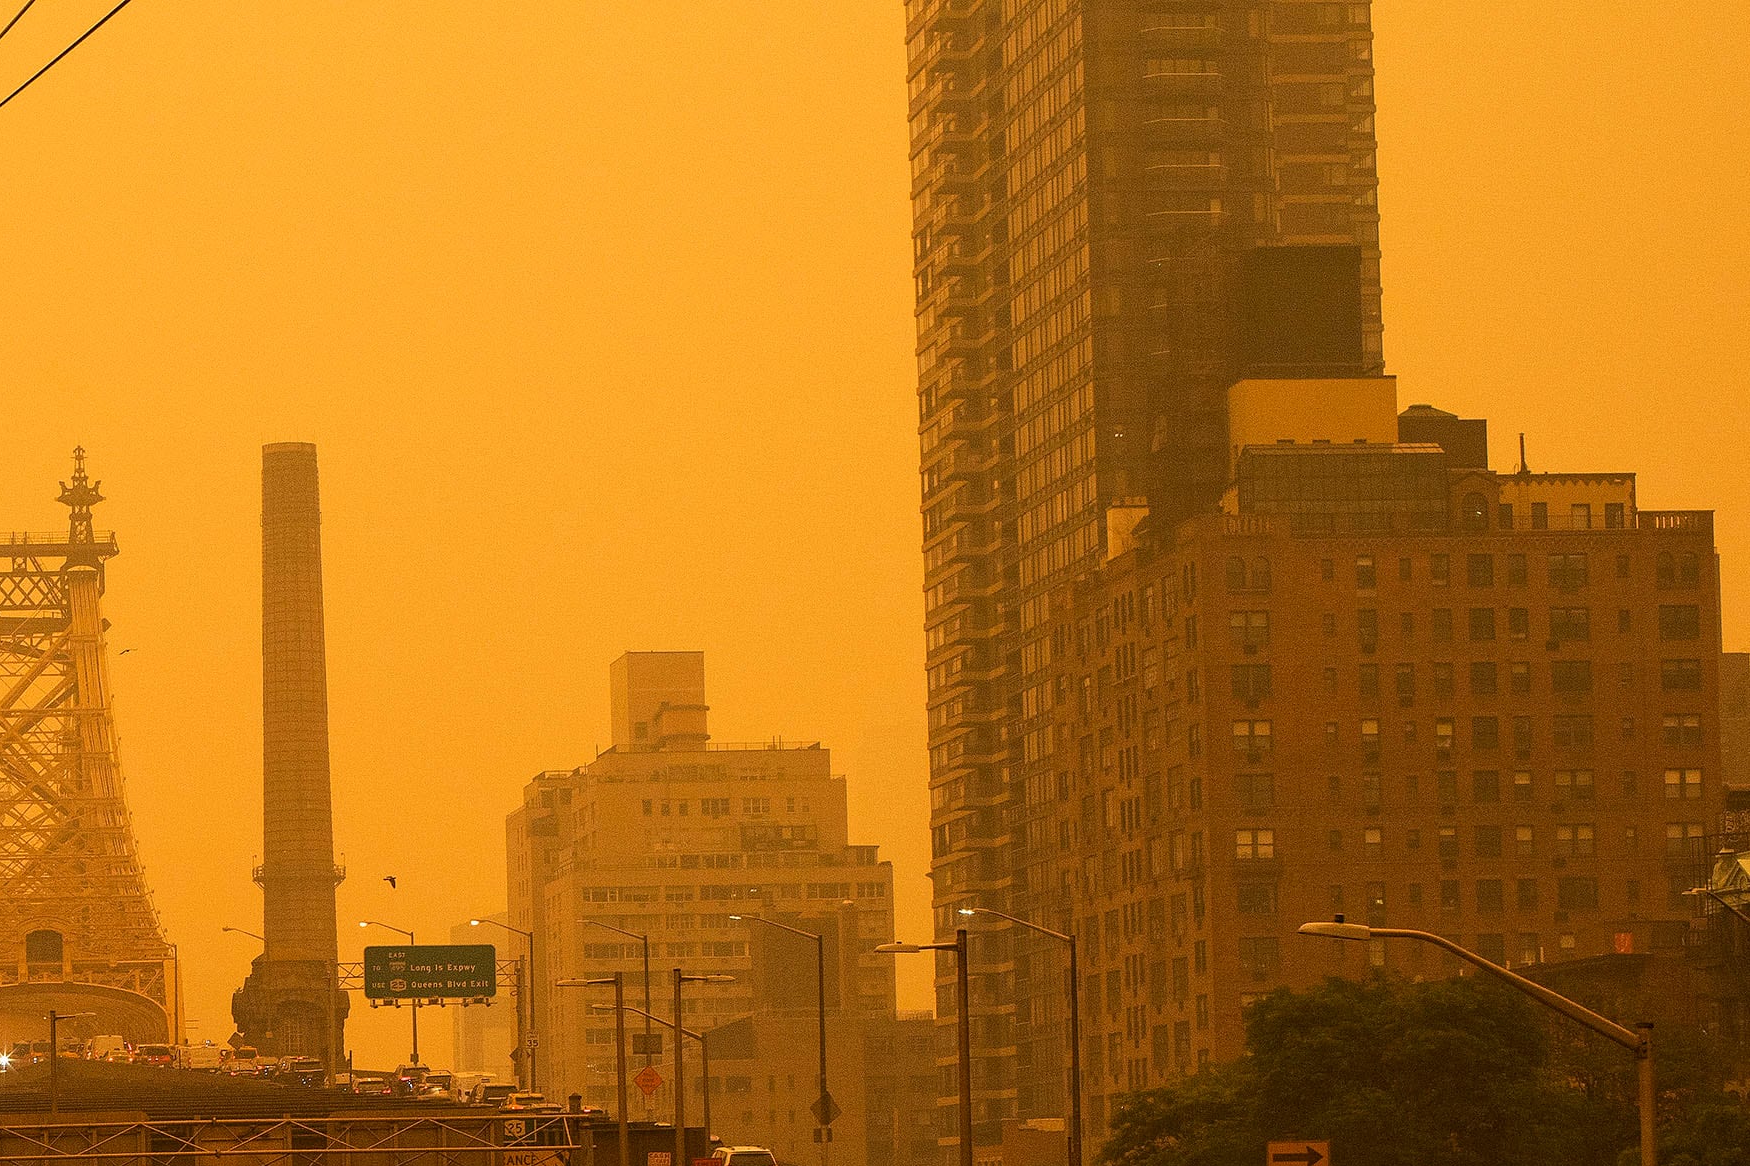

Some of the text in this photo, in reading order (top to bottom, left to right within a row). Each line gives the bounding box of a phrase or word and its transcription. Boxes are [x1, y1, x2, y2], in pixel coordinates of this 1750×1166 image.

[410, 964, 431, 973] Long
[447, 963, 476, 973] Expwy
[411, 981, 443, 989] Queens
[447, 980, 467, 988] Blvd
[470, 980, 489, 988] Exit
[526, 1039, 539, 1047] 35
